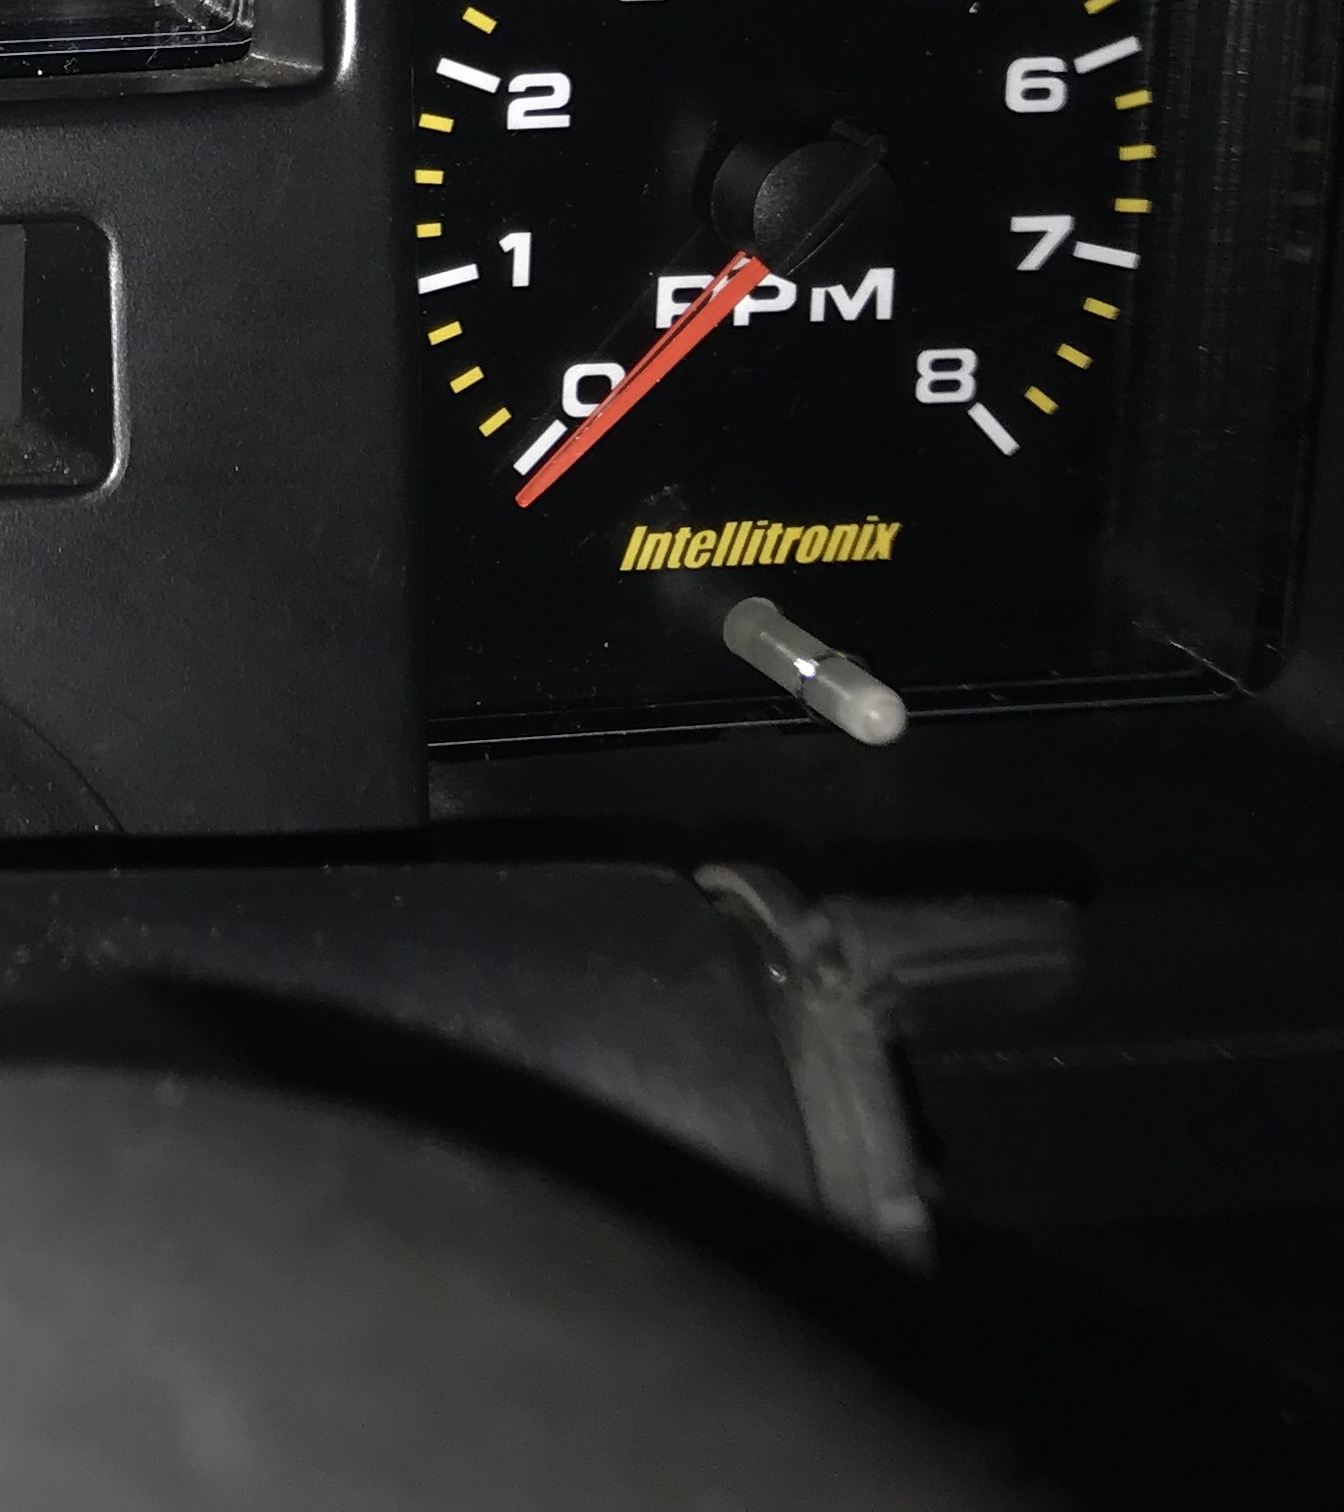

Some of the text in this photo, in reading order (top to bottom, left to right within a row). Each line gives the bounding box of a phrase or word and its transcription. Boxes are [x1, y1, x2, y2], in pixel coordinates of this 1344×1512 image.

[506, 72, 571, 130] 2
[1005, 56, 1066, 113] 6
[498, 231, 532, 288] 1
[1010, 215, 1073, 271] 7
[562, 362, 626, 418] 0
[915, 348, 977, 404] 8
[619, 515, 901, 571] Intellitronix
